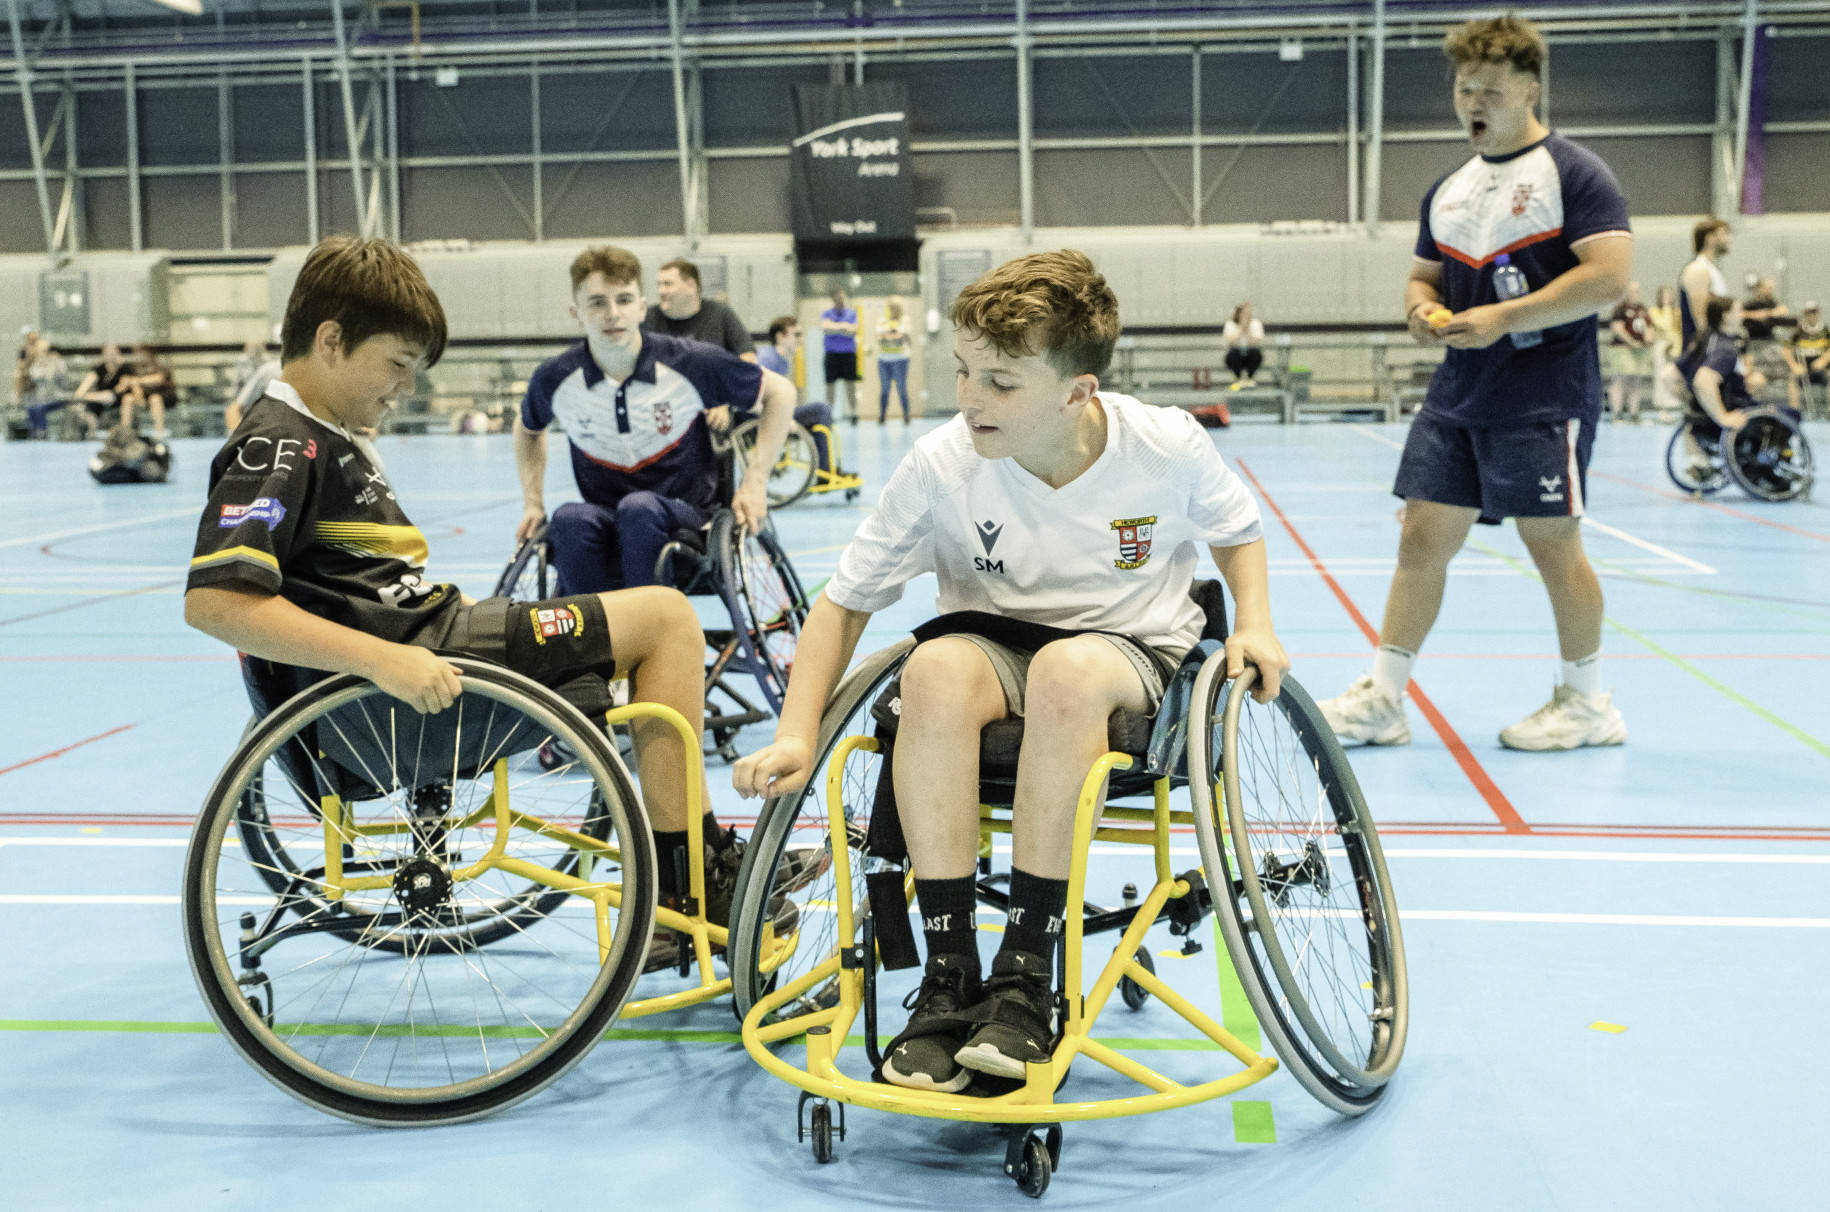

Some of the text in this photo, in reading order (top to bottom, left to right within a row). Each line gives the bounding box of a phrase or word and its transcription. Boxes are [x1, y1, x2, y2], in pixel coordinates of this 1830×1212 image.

[811, 137, 899, 159] York Sport
[858, 162, 899, 176] Arena
[974, 557, 1004, 574] SM
